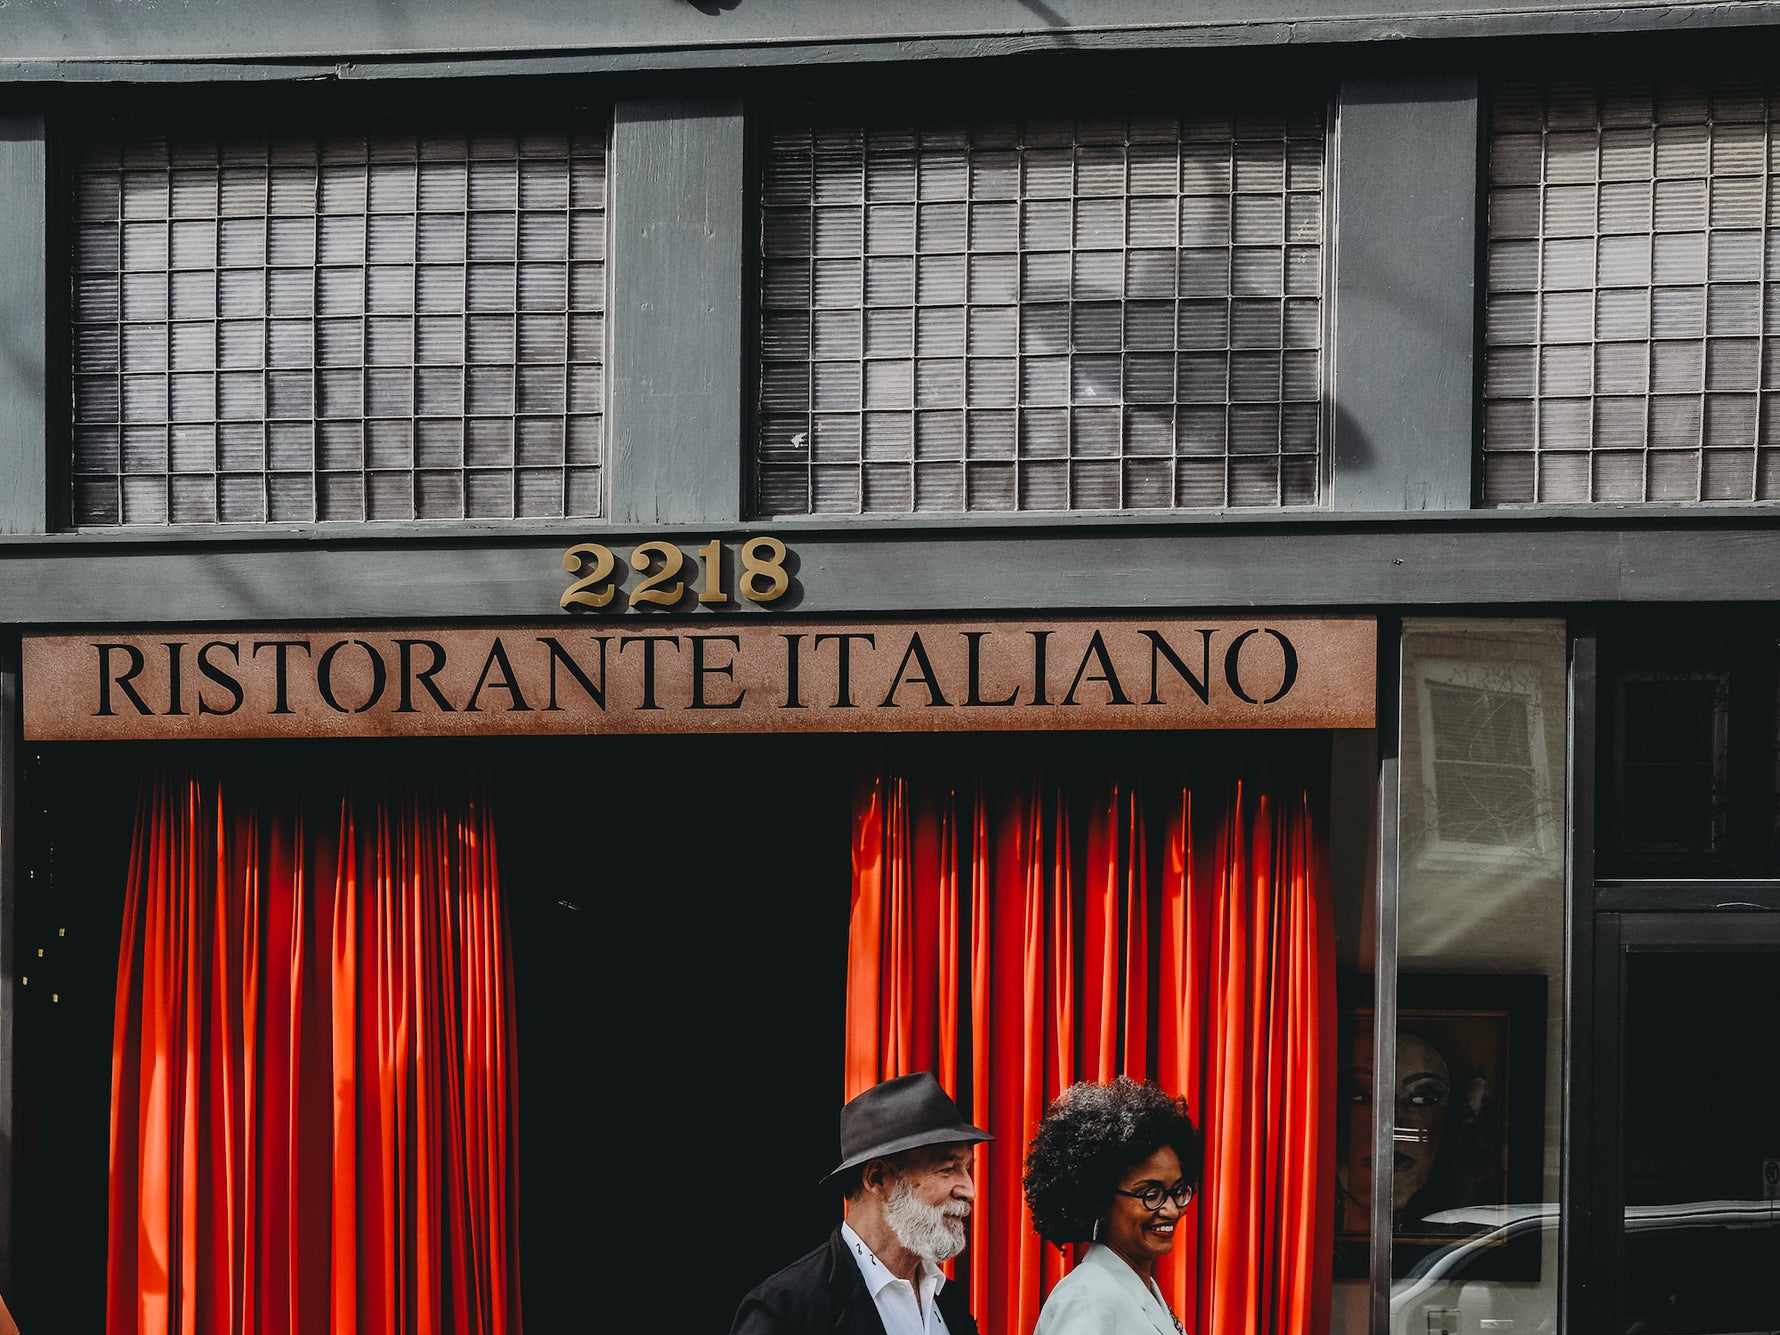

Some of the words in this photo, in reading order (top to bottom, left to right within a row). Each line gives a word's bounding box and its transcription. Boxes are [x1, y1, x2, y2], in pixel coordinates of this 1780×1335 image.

[560, 536, 790, 608] 2218
[90, 634, 747, 717] RISTORANTE
[778, 628, 1300, 709] ITALIANO
